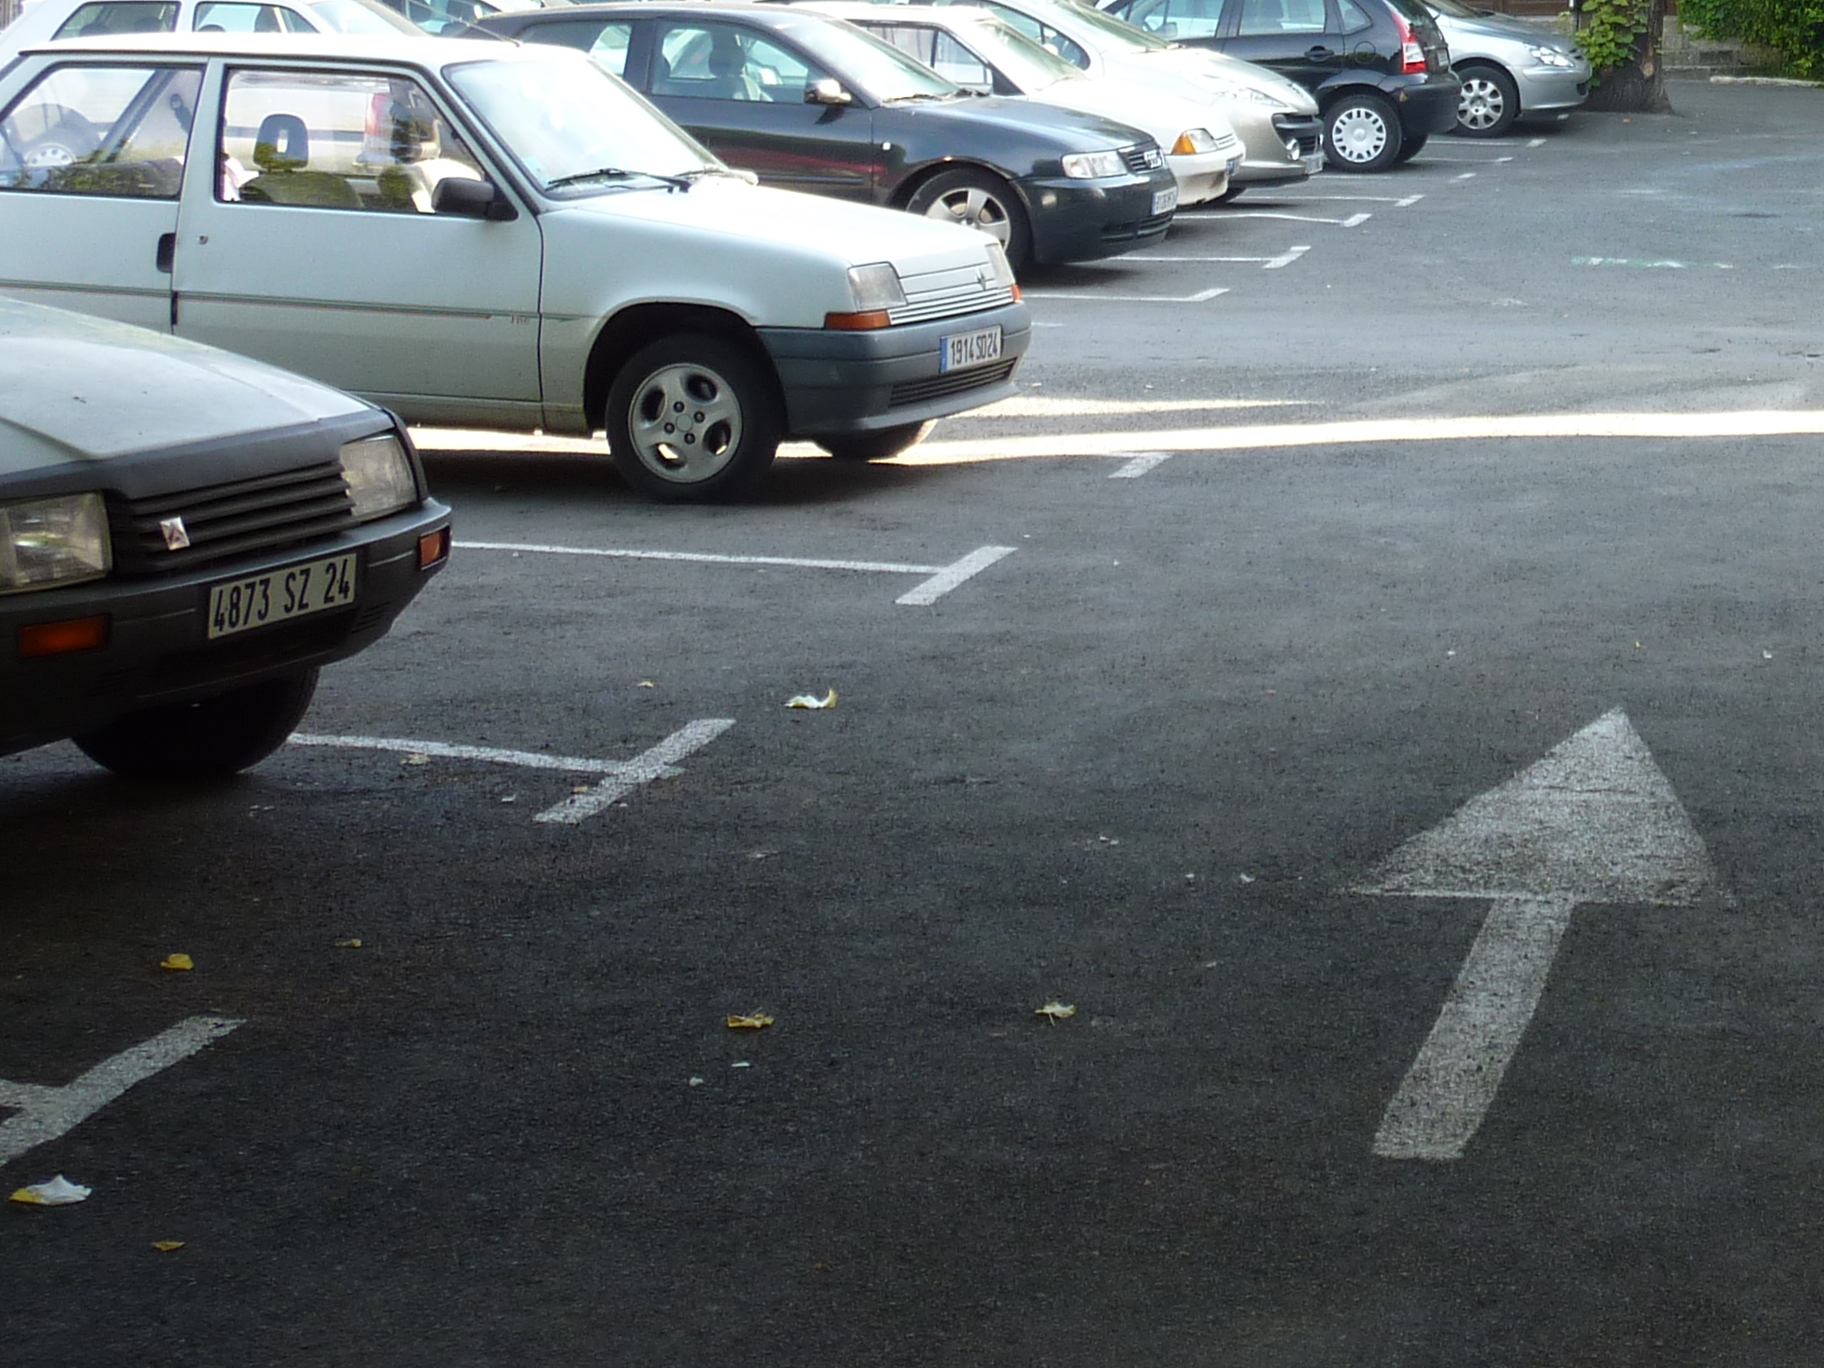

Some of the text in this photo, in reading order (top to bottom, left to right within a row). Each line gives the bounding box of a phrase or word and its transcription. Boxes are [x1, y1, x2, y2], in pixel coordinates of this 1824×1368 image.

[213, 558, 349, 631] 4873 SZ 24
